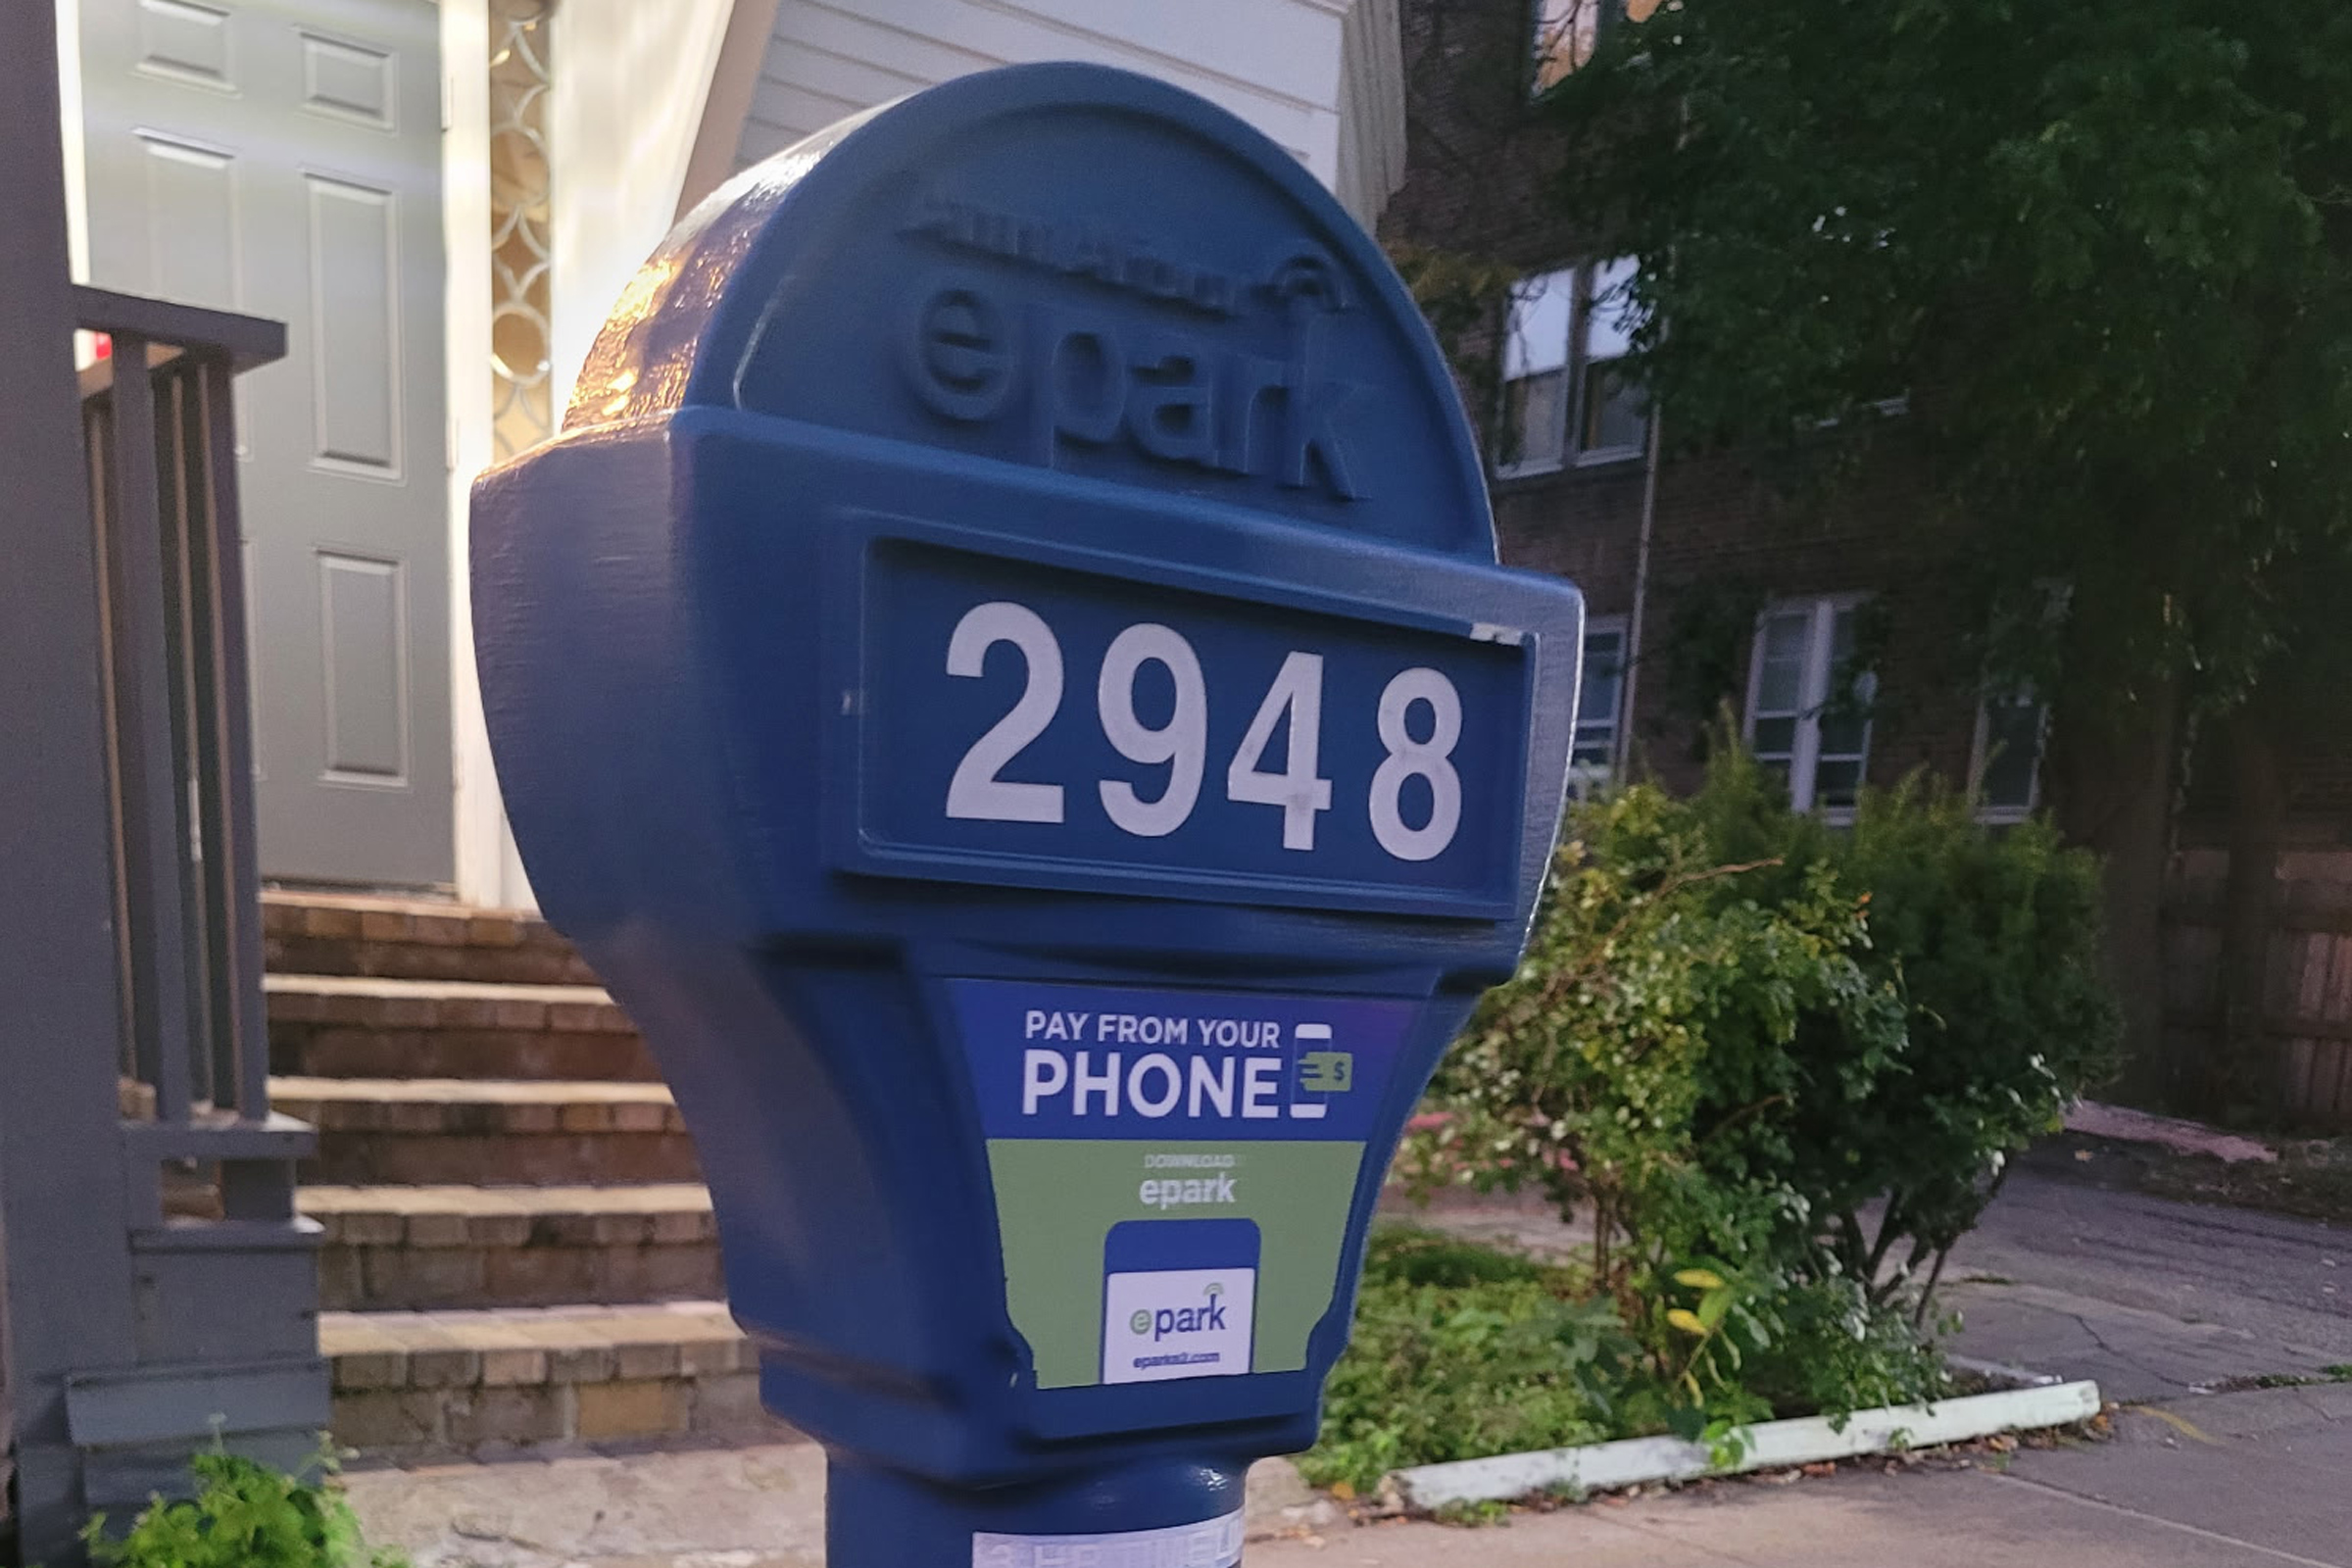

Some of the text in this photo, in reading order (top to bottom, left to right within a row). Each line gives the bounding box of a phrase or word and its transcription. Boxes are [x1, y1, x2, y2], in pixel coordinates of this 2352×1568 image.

[909, 284, 1368, 502] epark
[946, 601, 1463, 862] 2948
[1025, 1009, 1281, 1048] PAY FROM YOUR
[1022, 1049, 1283, 1119] PHONE
[1144, 1153, 1235, 1169] DOWNLOAD
[1139, 1171, 1238, 1210] epark
[1129, 1293, 1227, 1342] epark
